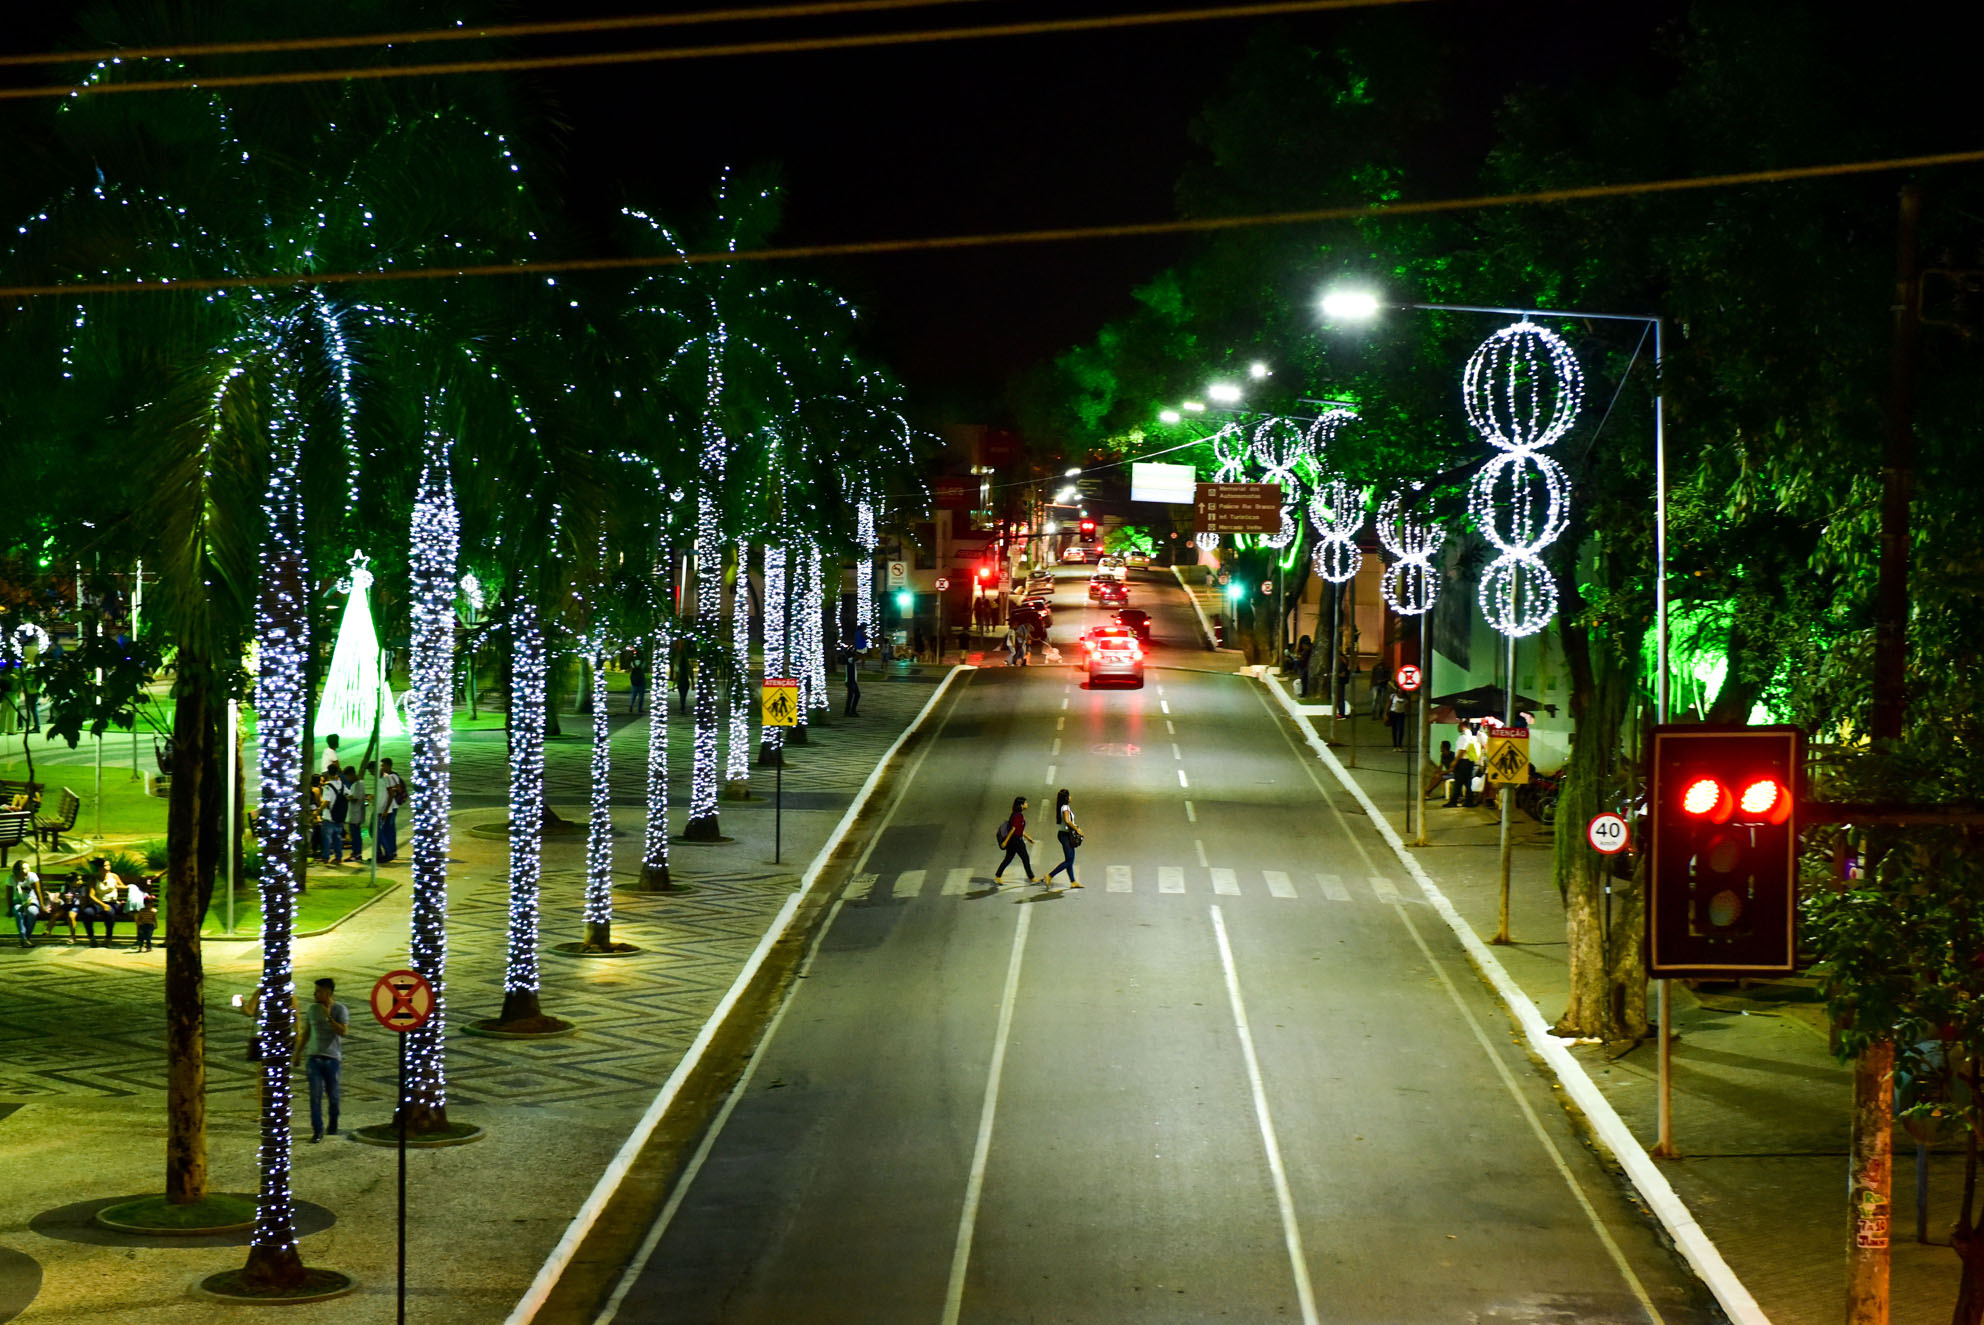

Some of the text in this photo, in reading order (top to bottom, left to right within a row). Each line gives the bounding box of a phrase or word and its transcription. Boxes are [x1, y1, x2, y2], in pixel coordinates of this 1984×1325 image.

[764, 679, 796, 687] ATENÇÃO
[1491, 728, 1527, 737] ATENÇÃO
[1595, 822, 1620, 838] 40
